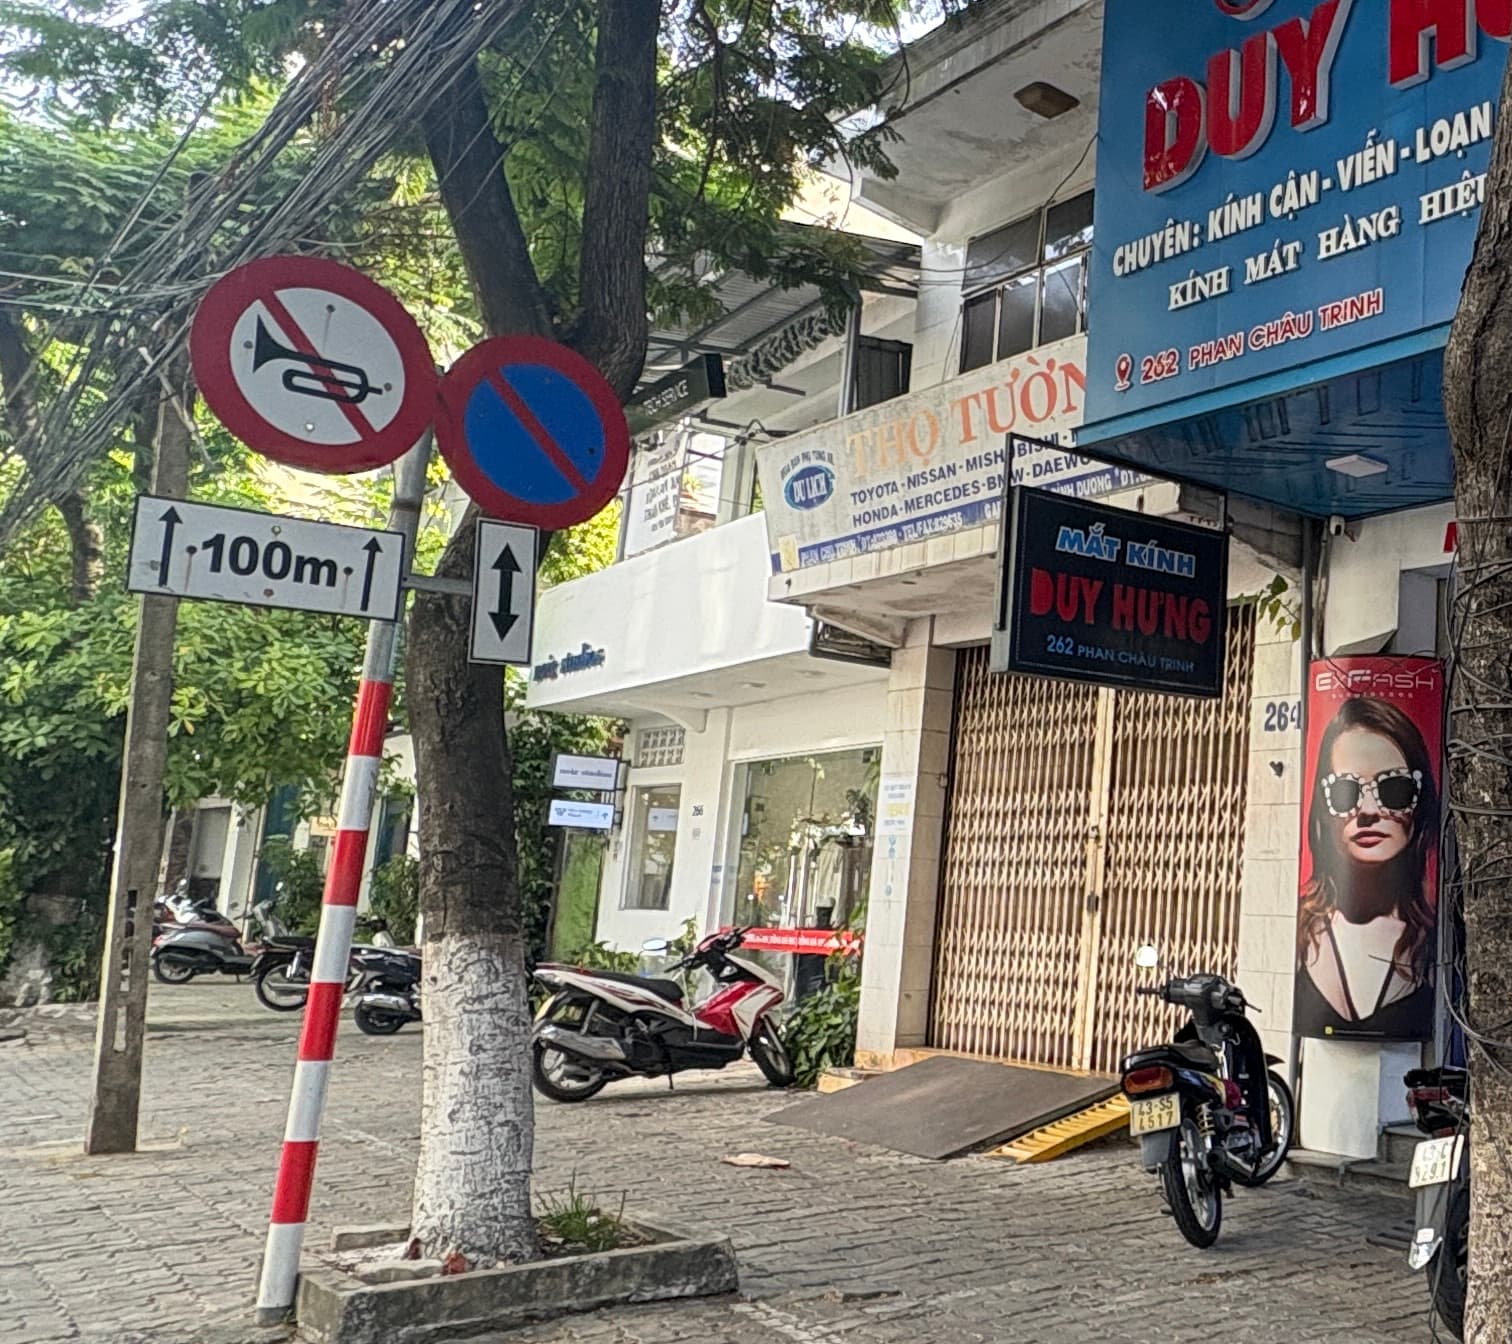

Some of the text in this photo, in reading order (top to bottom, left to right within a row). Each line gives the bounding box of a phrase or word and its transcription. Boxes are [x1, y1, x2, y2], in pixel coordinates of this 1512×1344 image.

[1113, 218, 1201, 277] CHUYÊN:
[1208, 193, 1263, 242] KÍNH
[1269, 171, 1319, 220] CẬN
[1337, 129, 1395, 192] VIỄN
[1415, 102, 1493, 163] LOẠN
[1168, 266, 1230, 311] KÍNH
[1244, 239, 1301, 285] MÁT
[1317, 206, 1401, 261] HÀNG
[1140, 350, 1179, 384] 262
[1188, 332, 1242, 370] PHAN
[1248, 312, 1313, 351] CHÂU
[1319, 288, 1384, 330] TRINH
[847, 355, 1087, 478] THỢ TƯỜN
[202, 533, 337, 588] 100m
[1055, 522, 1196, 578] MẮT KÍNH
[1030, 567, 1212, 644] DUY HƯNG
[1046, 634, 1074, 656] 262
[1077, 644, 1115, 662] PHAN
[1160, 657, 1195, 673] TRINH
